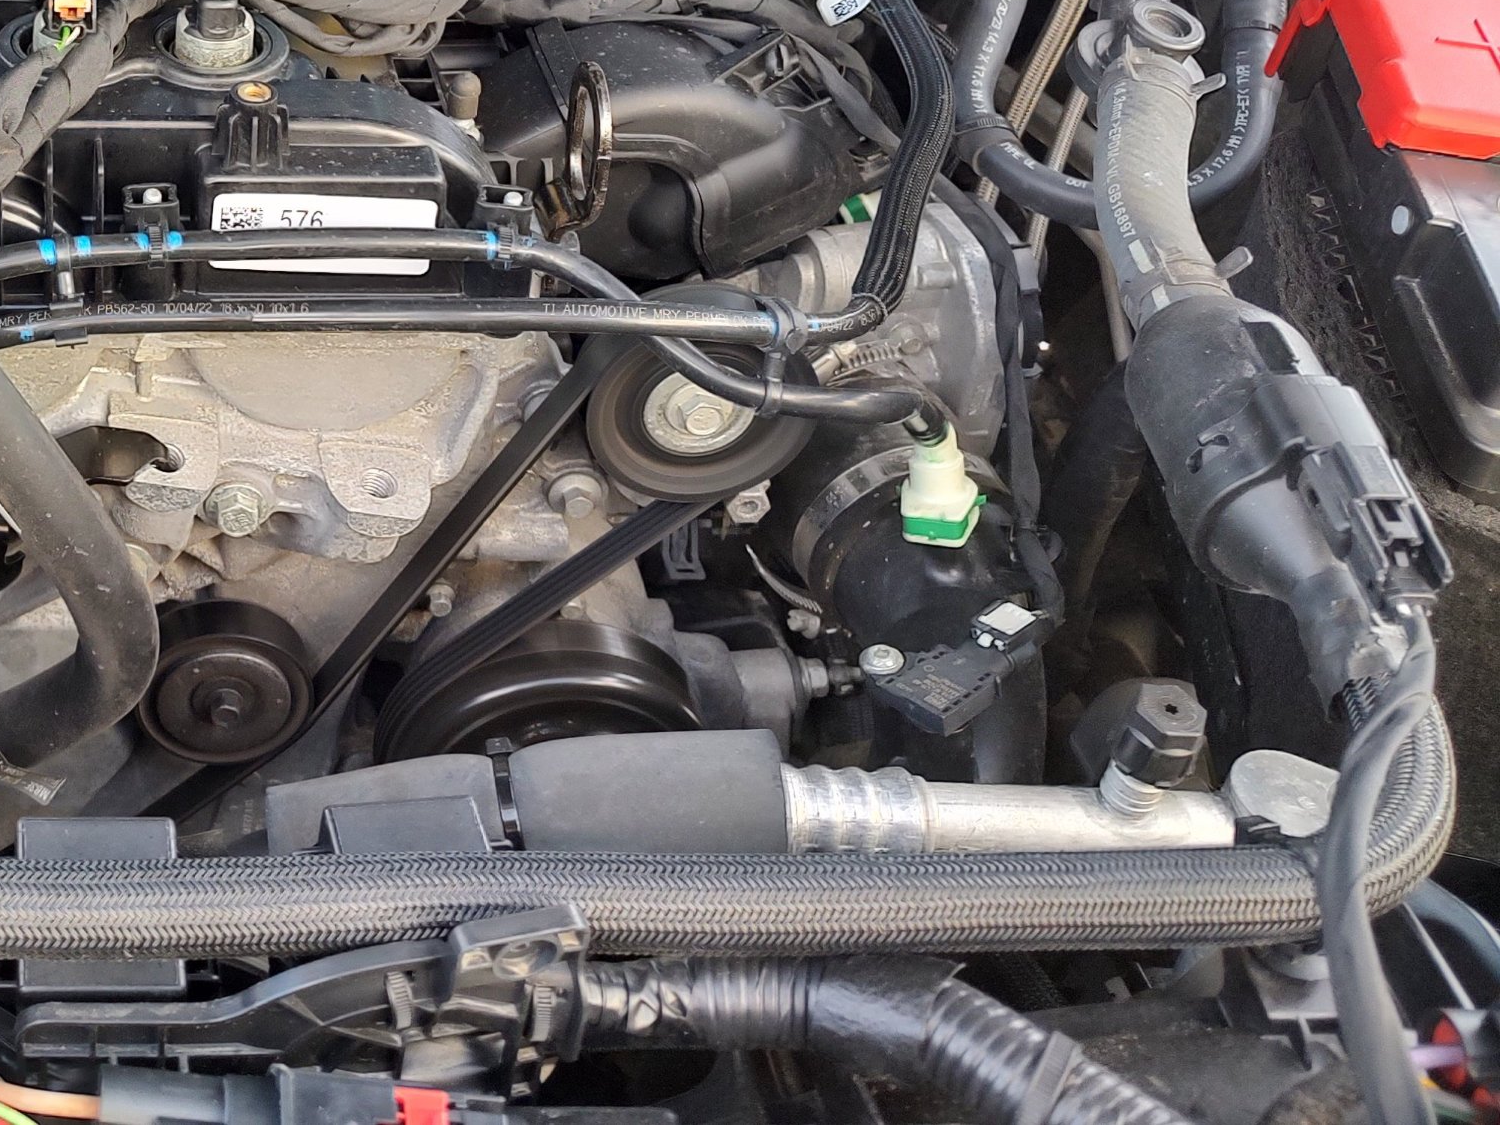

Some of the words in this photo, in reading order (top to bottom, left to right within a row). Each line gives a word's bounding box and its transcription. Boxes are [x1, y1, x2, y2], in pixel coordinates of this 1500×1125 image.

[280, 209, 324, 227] 576
[1108, 184, 1136, 238] GB16897
[0, 314, 23, 328] MRY
[97, 305, 155, 315] PB562-50
[164, 303, 212, 313] 10/04/22
[542, 303, 556, 316] TI
[563, 304, 648, 319] AUTOMOTIVE
[653, 308, 681, 321] MRY
